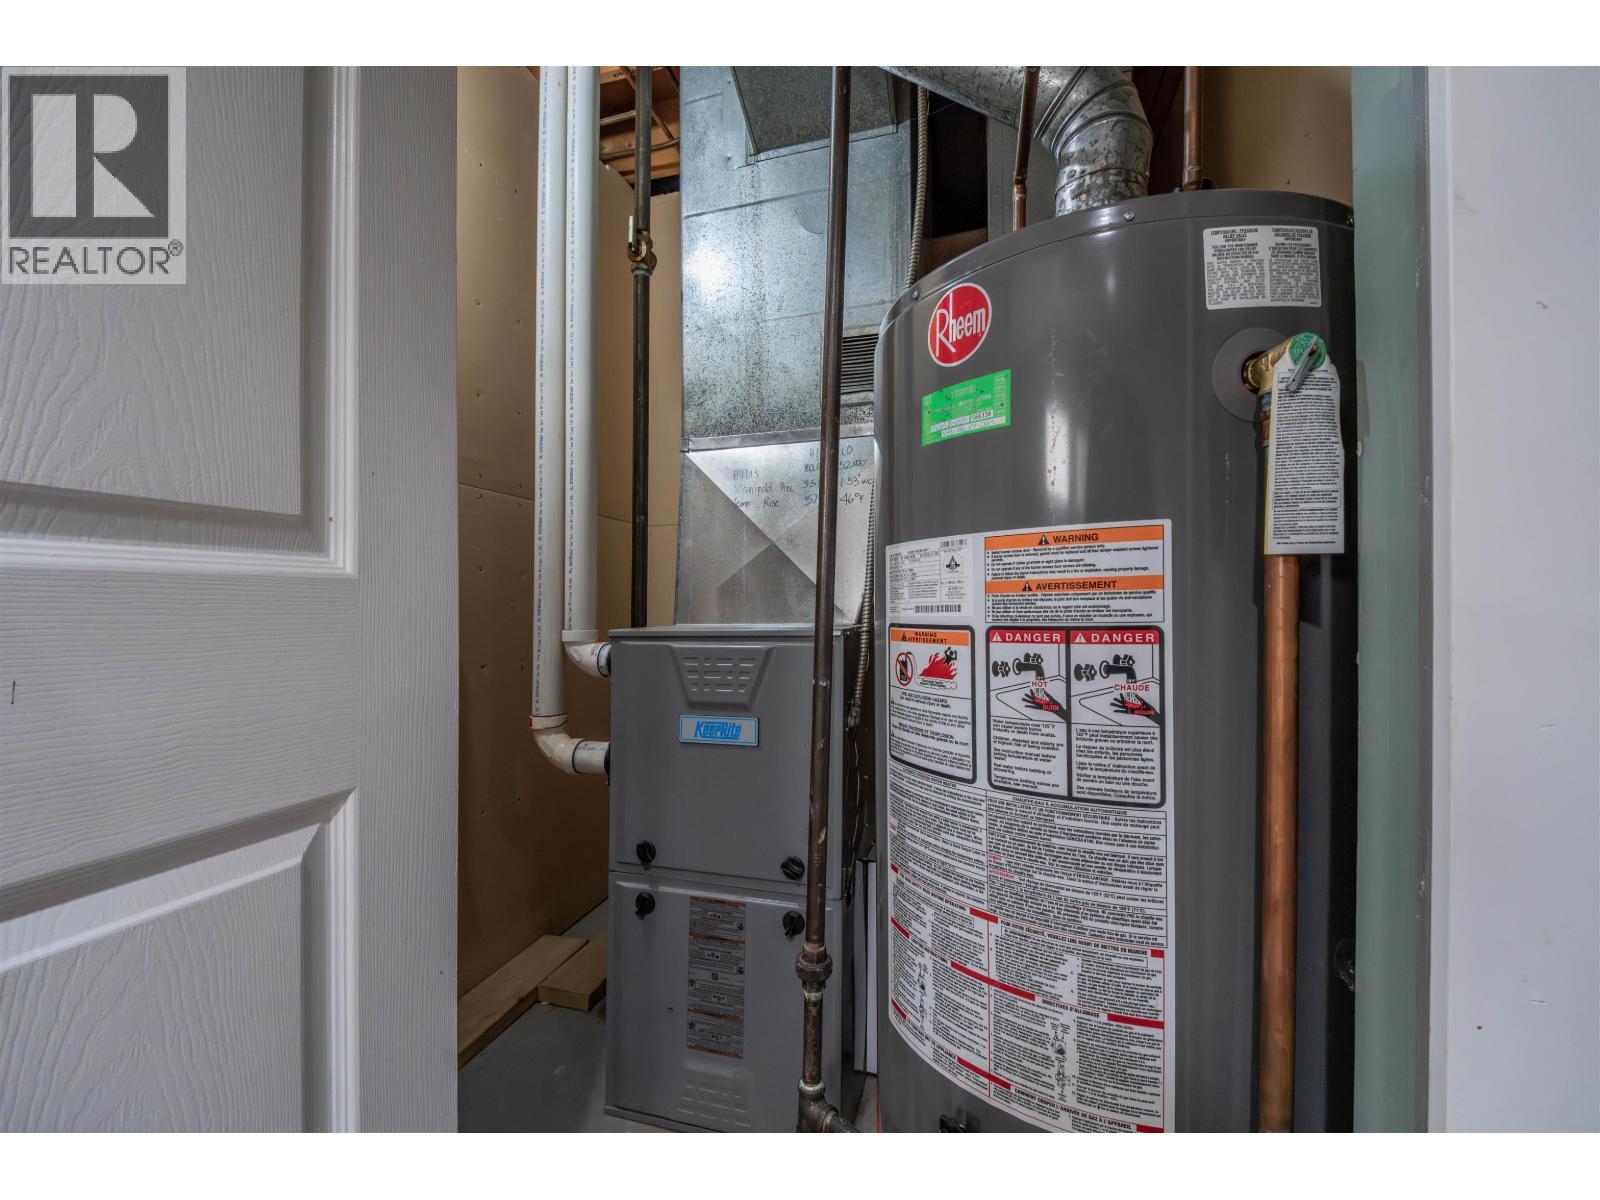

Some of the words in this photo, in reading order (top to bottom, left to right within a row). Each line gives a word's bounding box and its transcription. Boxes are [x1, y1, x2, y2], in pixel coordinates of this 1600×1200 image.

[935, 292, 986, 357] Rheem
[764, 497, 779, 508] Rise
[1053, 533, 1099, 543] WARNING
[1036, 581, 1118, 590] AVERTISSEMENT
[1006, 633, 1061, 642] DANGER
[1092, 633, 1154, 643] DANGER
[1114, 684, 1150, 692] CHAUDE
[1091, 808, 1128, 816] AUTOMATIQUE
